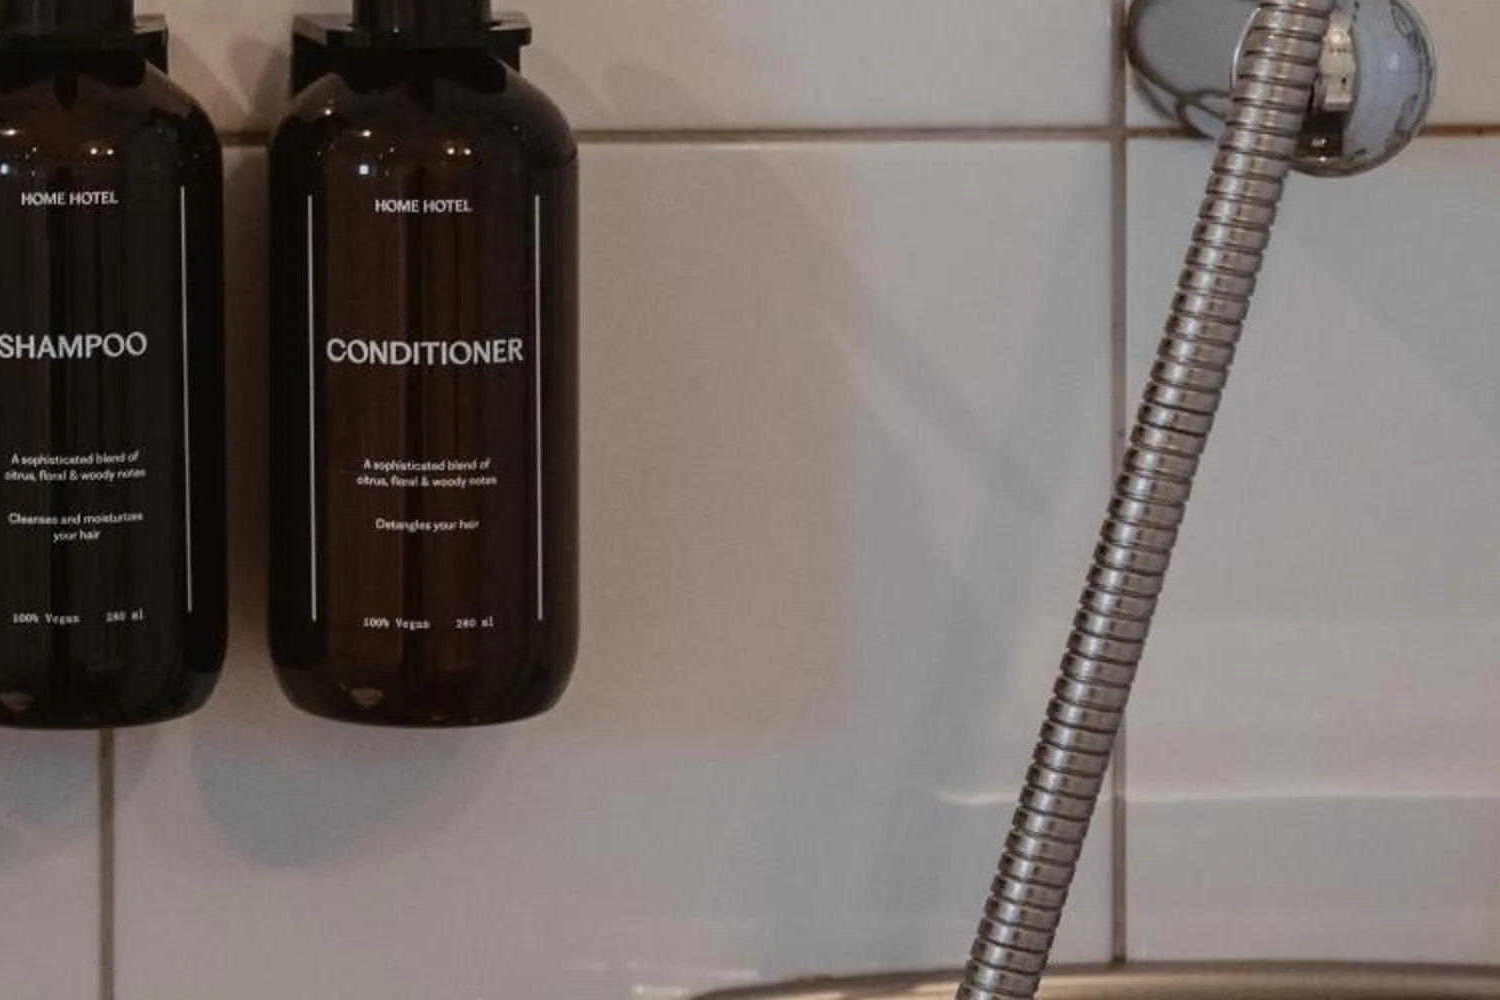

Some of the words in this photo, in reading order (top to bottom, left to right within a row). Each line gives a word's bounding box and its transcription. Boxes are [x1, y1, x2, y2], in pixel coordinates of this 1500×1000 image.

[21, 191, 67, 206] HOME
[69, 190, 119, 206] HOTEL
[375, 199, 420, 213] HOME
[422, 199, 473, 213] HOTEL
[325, 336, 525, 367] CONDITIONER
[11, 453, 19, 465] A
[21, 452, 94, 468] sophisticated
[95, 452, 125, 465] blend
[127, 450, 140, 462] of
[363, 458, 371, 470] A
[373, 459, 445, 472] sophisticated
[447, 459, 477, 471] blend
[479, 458, 491, 469] of
[39, 469, 67, 481] floral
[69, 469, 78, 481] &
[80, 469, 115, 481] woody
[356, 475, 389, 487] citrus,
[420, 476, 429, 487] &
[432, 476, 466, 488] woody
[60, 513, 81, 525] and
[375, 518, 432, 532] Detangles
[433, 520, 458, 532] your
[459, 519, 479, 529] hair
[52, 531, 78, 543] your
[80, 530, 101, 540] hair
[45, 612, 81, 626] Vegan
[362, 617, 390, 629] 100%
[395, 618, 431, 631] Vegan
